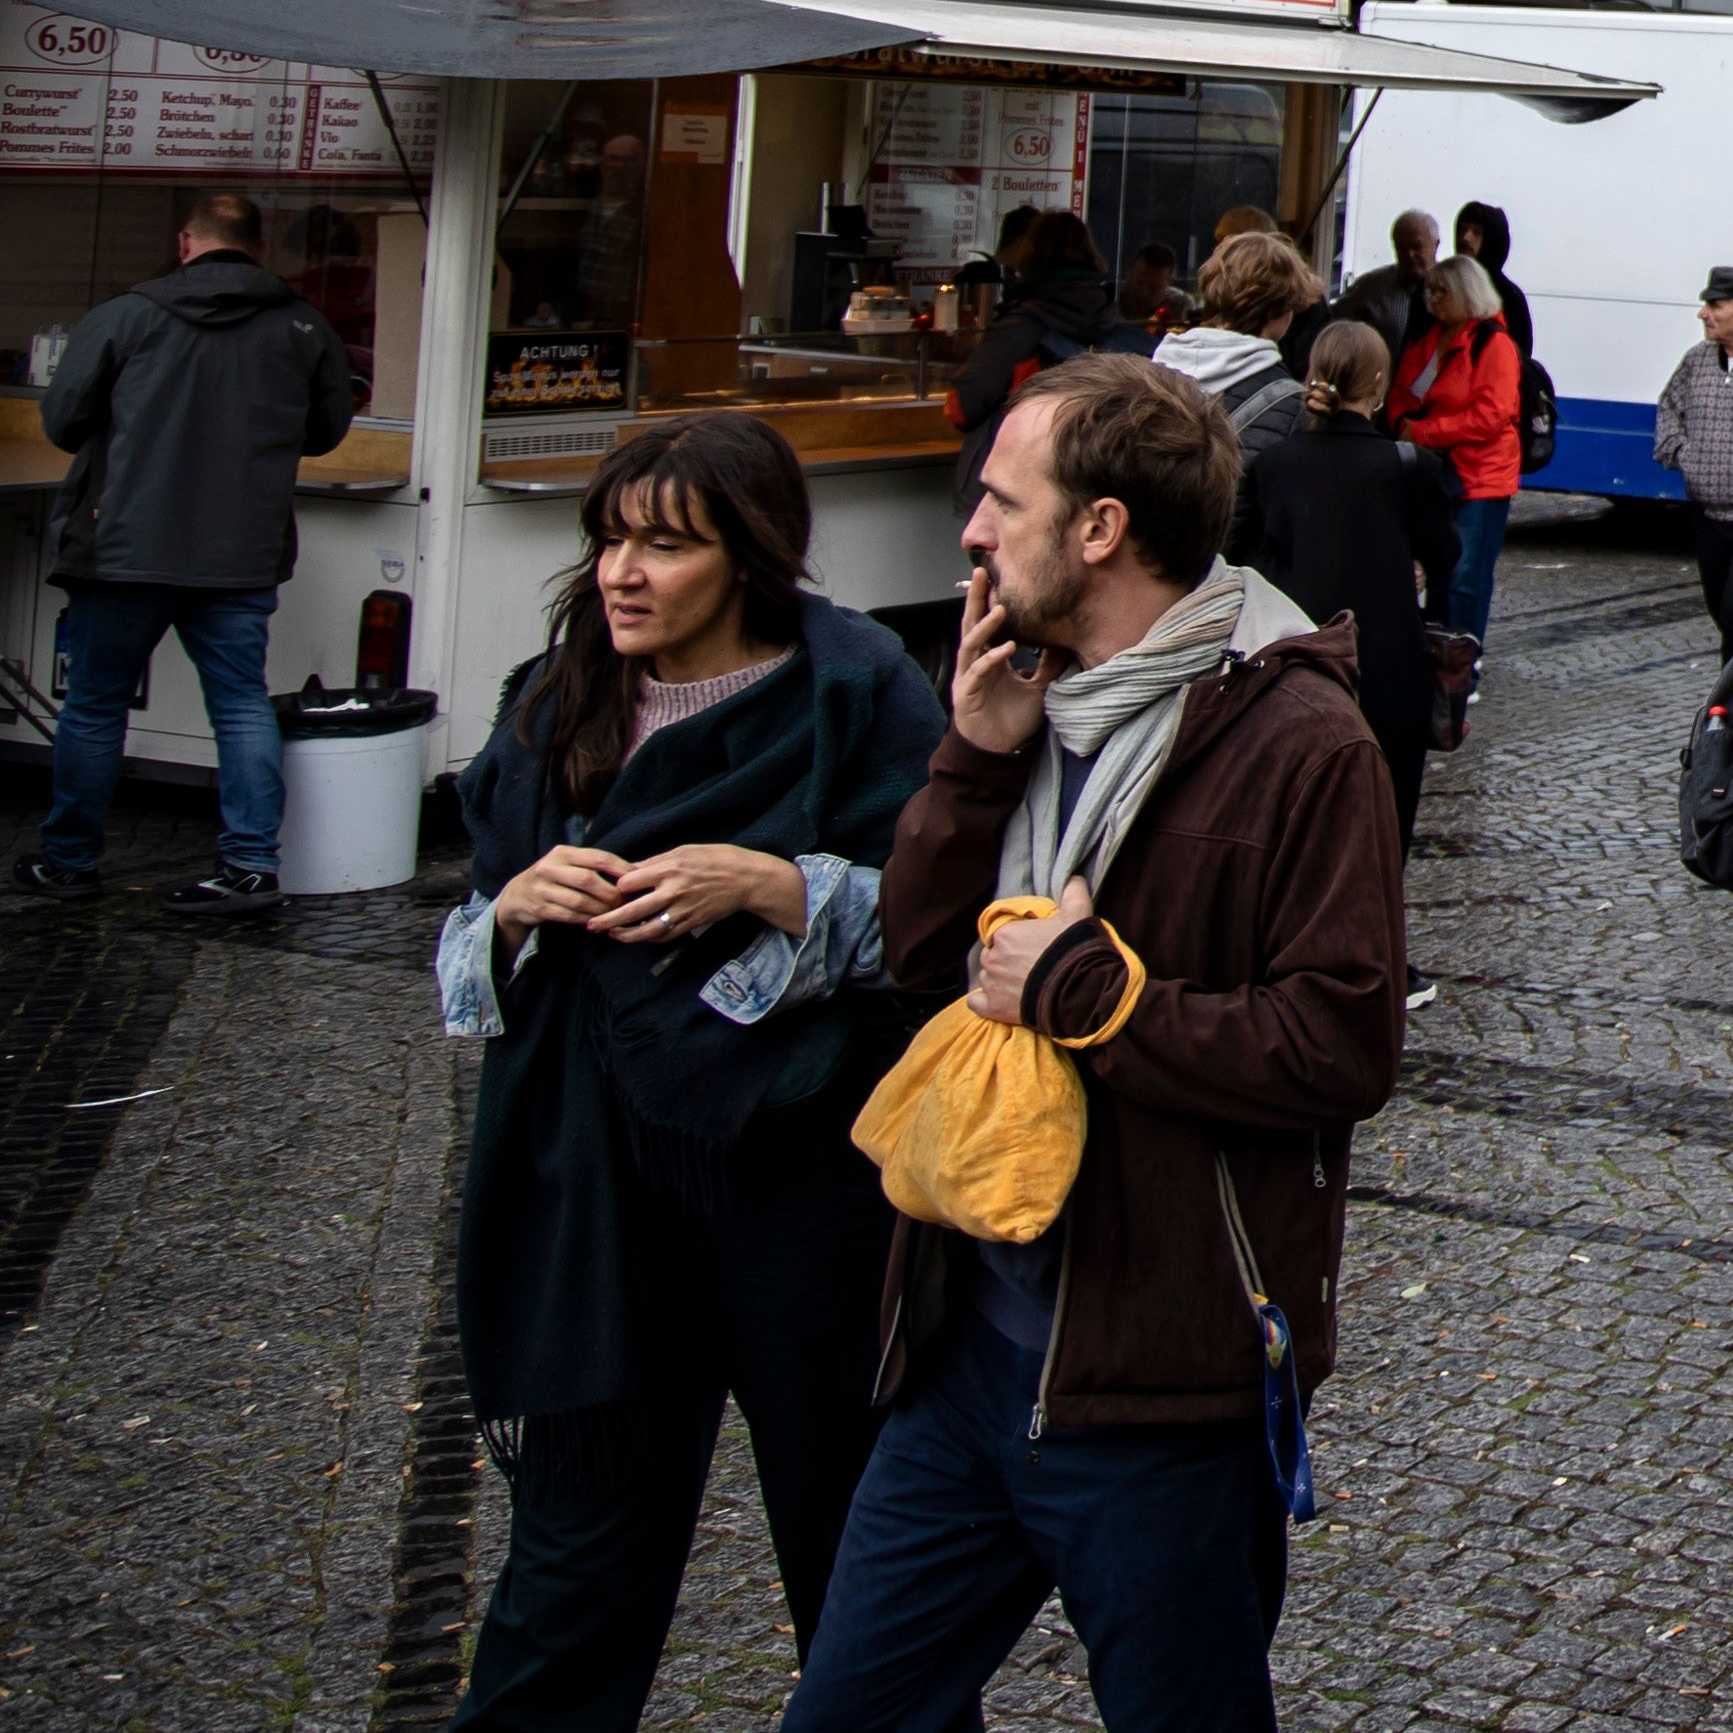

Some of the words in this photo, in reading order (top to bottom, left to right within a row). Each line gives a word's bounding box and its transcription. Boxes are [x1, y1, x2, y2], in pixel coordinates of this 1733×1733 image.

[38, 23, 106, 55] 6,50
[4, 84, 79, 100] Currywurst
[323, 98, 360, 111] Kaffee
[159, 109, 215, 123] Brötchen
[321, 114, 358, 127] Kakao
[0, 139, 55, 154] Pommes
[58, 141, 95, 154] Frites
[1014, 135, 1050, 158] 6,50
[520, 344, 590, 359] ACHTUNG
